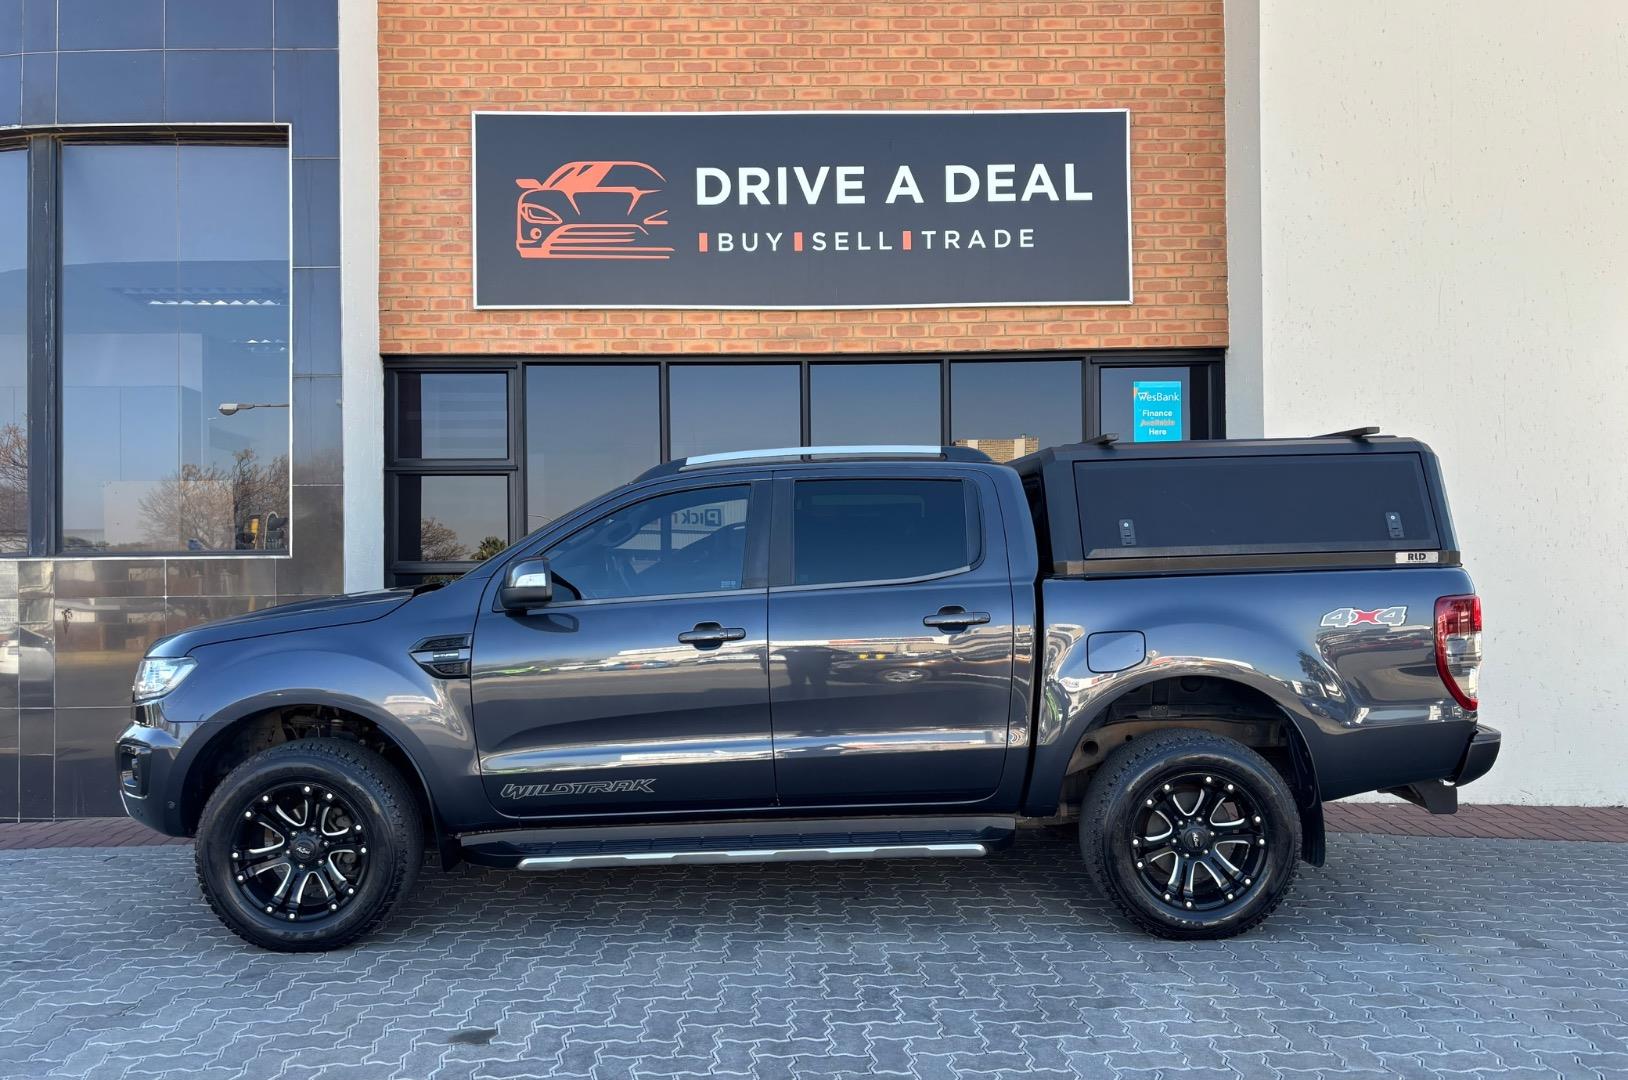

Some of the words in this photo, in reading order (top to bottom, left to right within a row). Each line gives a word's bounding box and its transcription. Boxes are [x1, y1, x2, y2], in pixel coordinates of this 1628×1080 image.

[696, 166, 866, 206] DRIVE
[885, 165, 925, 204] A
[945, 163, 1093, 203] DEAL
[718, 232, 783, 252] BUY
[812, 231, 893, 251] SELL
[921, 229, 1035, 250] TRADE
[1138, 392, 1179, 401] WesBank
[1142, 409, 1173, 417] Finance
[500, 778, 657, 800] WILDTRAK
